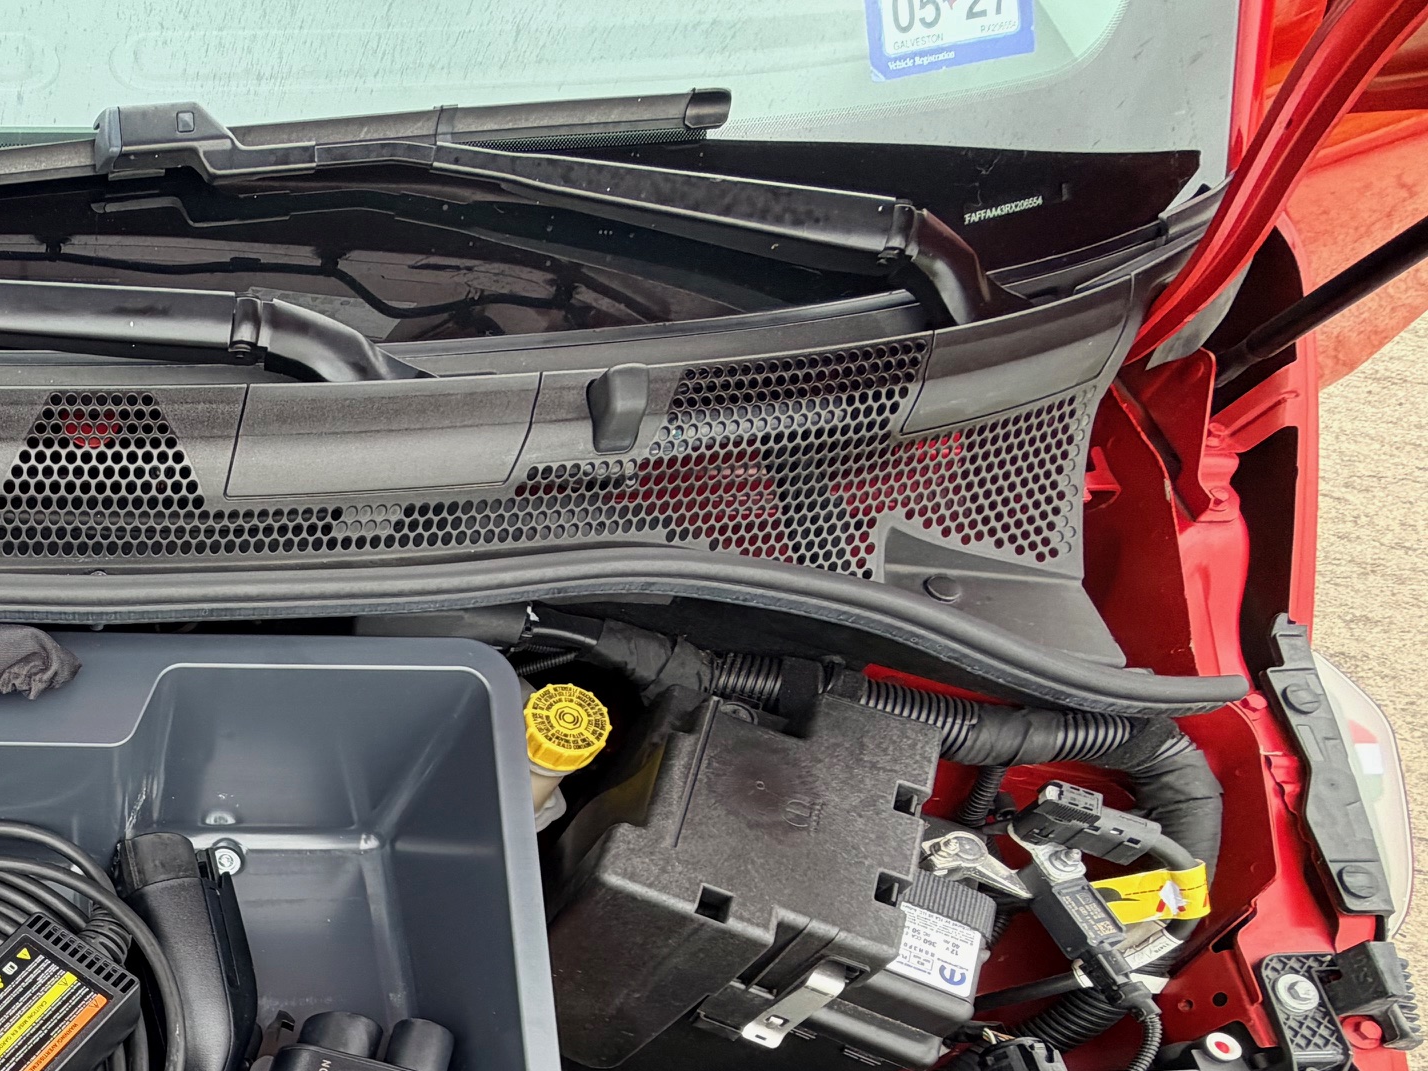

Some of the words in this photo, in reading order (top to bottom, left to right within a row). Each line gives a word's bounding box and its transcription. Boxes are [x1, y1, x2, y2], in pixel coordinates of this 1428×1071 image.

[892, 0, 942, 33] 05
[893, 33, 944, 50] GALVESTON
[888, 55, 914, 70] Vehicle
[914, 50, 955, 66] Registration
[910, 926, 921, 934] 50
[922, 937, 937, 948] 360
[950, 941, 960, 949] 40
[949, 948, 959, 956] 12
